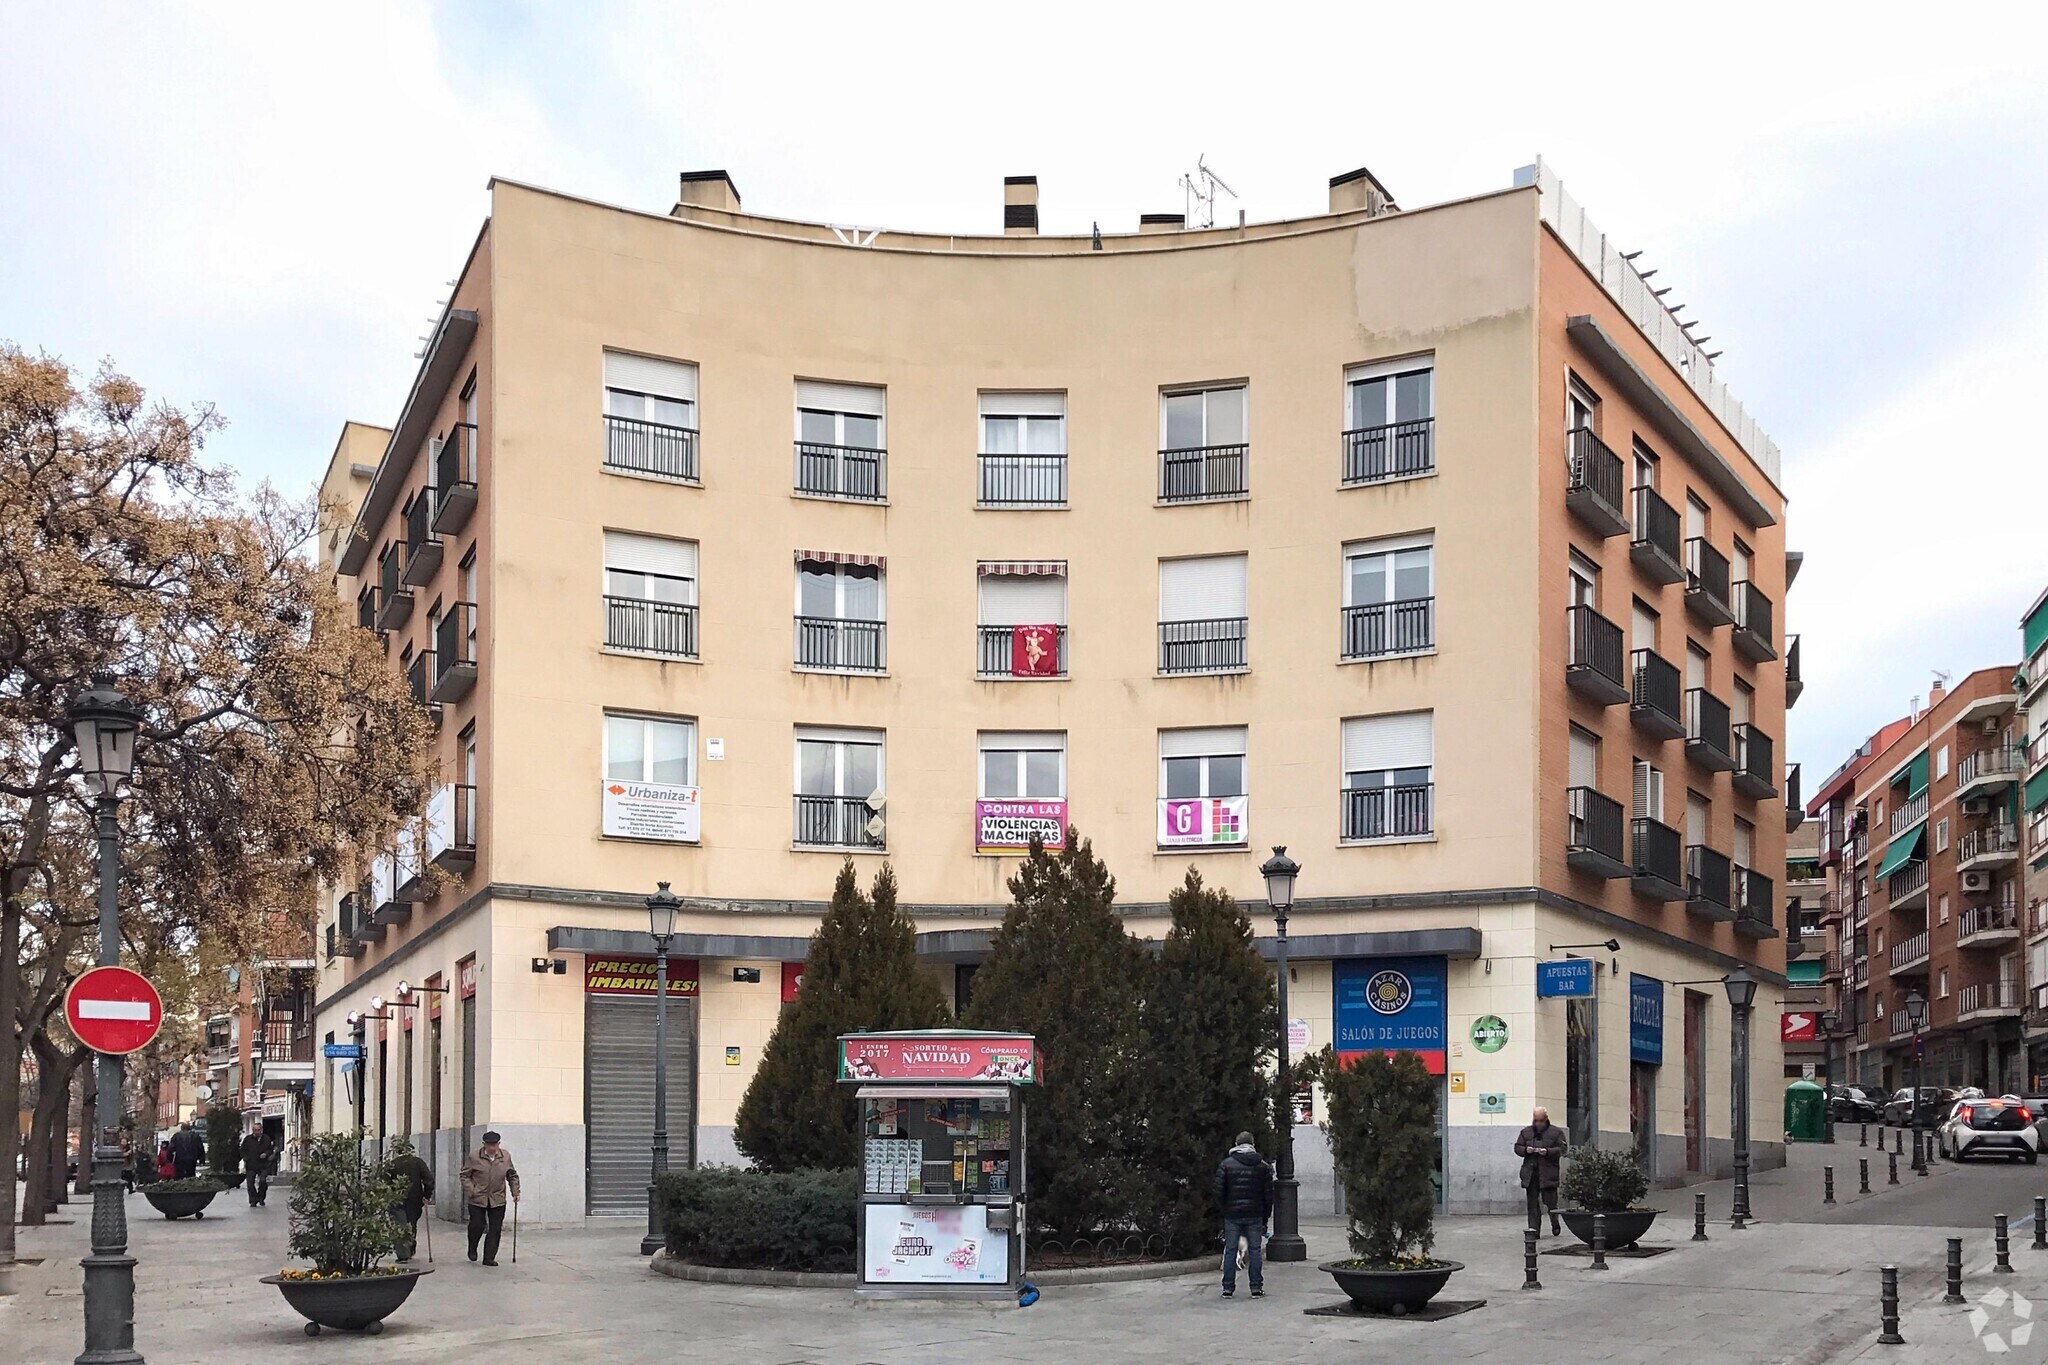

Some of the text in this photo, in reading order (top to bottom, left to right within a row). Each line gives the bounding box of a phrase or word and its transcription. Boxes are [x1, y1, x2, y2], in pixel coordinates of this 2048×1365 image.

[983, 804, 1061, 814] CONTRA LAS
[1176, 804, 1191, 833] G
[985, 819, 1058, 830] VIOLENCIAS
[587, 961, 659, 975] ¡PRECIO
[1546, 966, 1587, 978] APUESTAS
[1374, 974, 1403, 987] AZAR
[1558, 980, 1575, 991] BAR
[1370, 991, 1407, 1011] CASINOS
[1341, 1025, 1439, 1040] SALÓN DE JUEGOS
[1473, 1030, 1505, 1039] ABIERTO
[860, 1050, 890, 1058] 2017
[980, 1046, 1019, 1054] CÓMPRALO
[901, 1052, 971, 1064] NAVIDAD
[892, 1246, 932, 1256] JACKPOT
